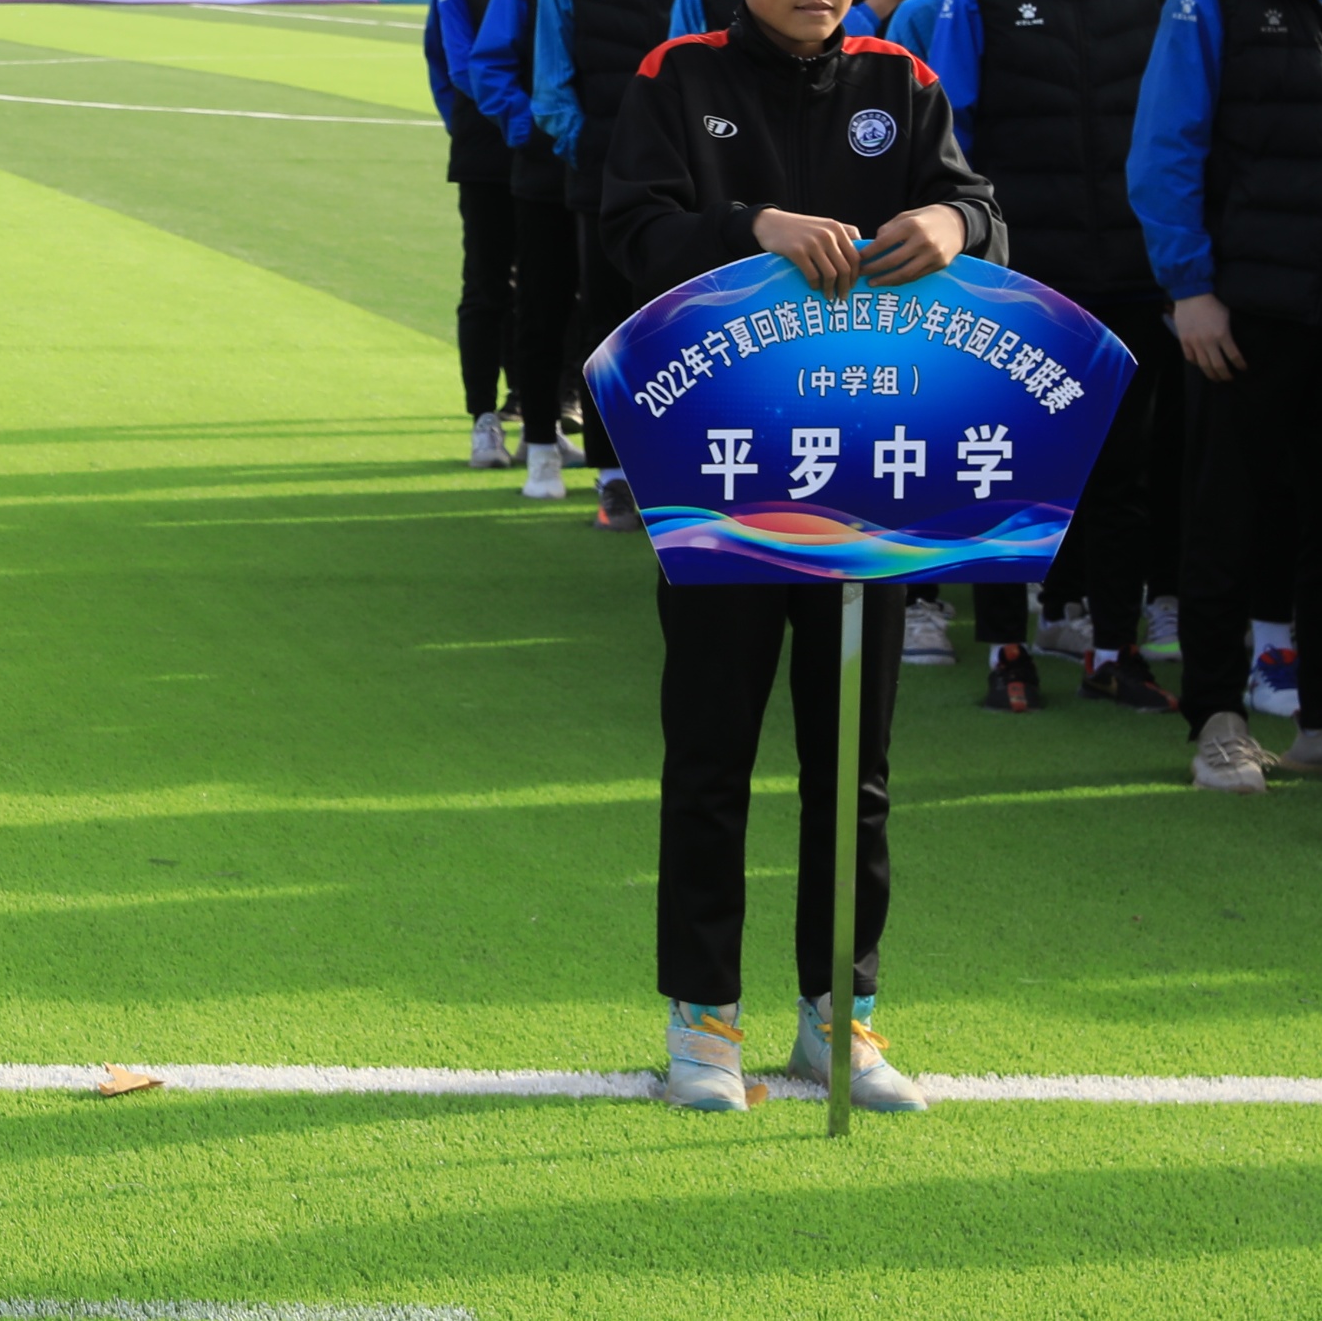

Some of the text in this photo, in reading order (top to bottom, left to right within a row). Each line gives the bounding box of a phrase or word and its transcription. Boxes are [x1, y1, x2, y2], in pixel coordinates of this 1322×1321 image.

[633, 292, 1086, 419] 2022年宁夏回族自治区青少年校园足球联赛
[699, 423, 1015, 502] 平罗中学
